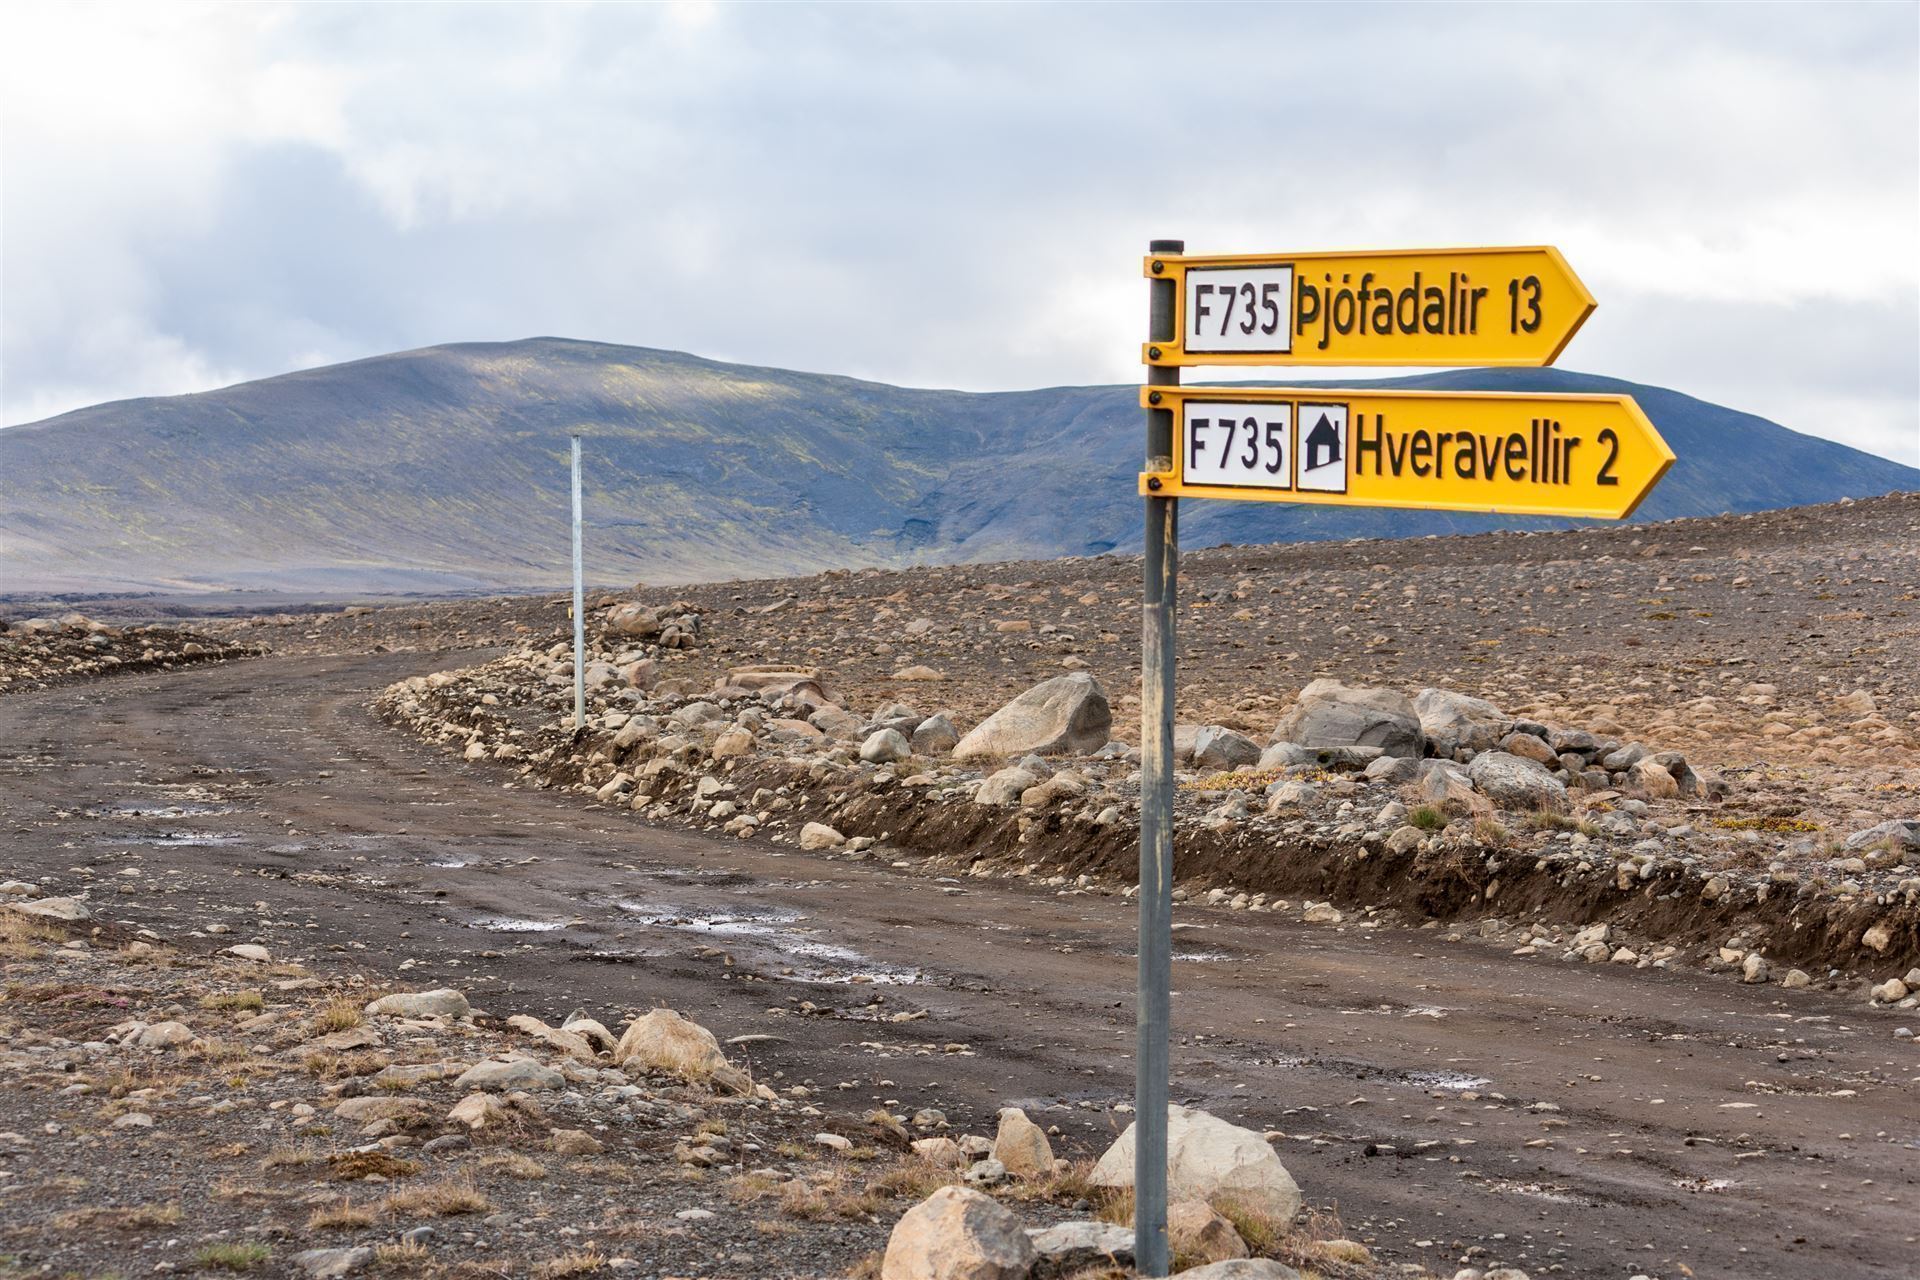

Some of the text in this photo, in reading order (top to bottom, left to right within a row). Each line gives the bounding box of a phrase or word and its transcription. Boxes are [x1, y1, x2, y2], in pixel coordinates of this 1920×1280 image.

[1194, 271, 1543, 350] F735 Þjófadalir 13
[1189, 413, 1620, 485] F735 Hveravellir 2
